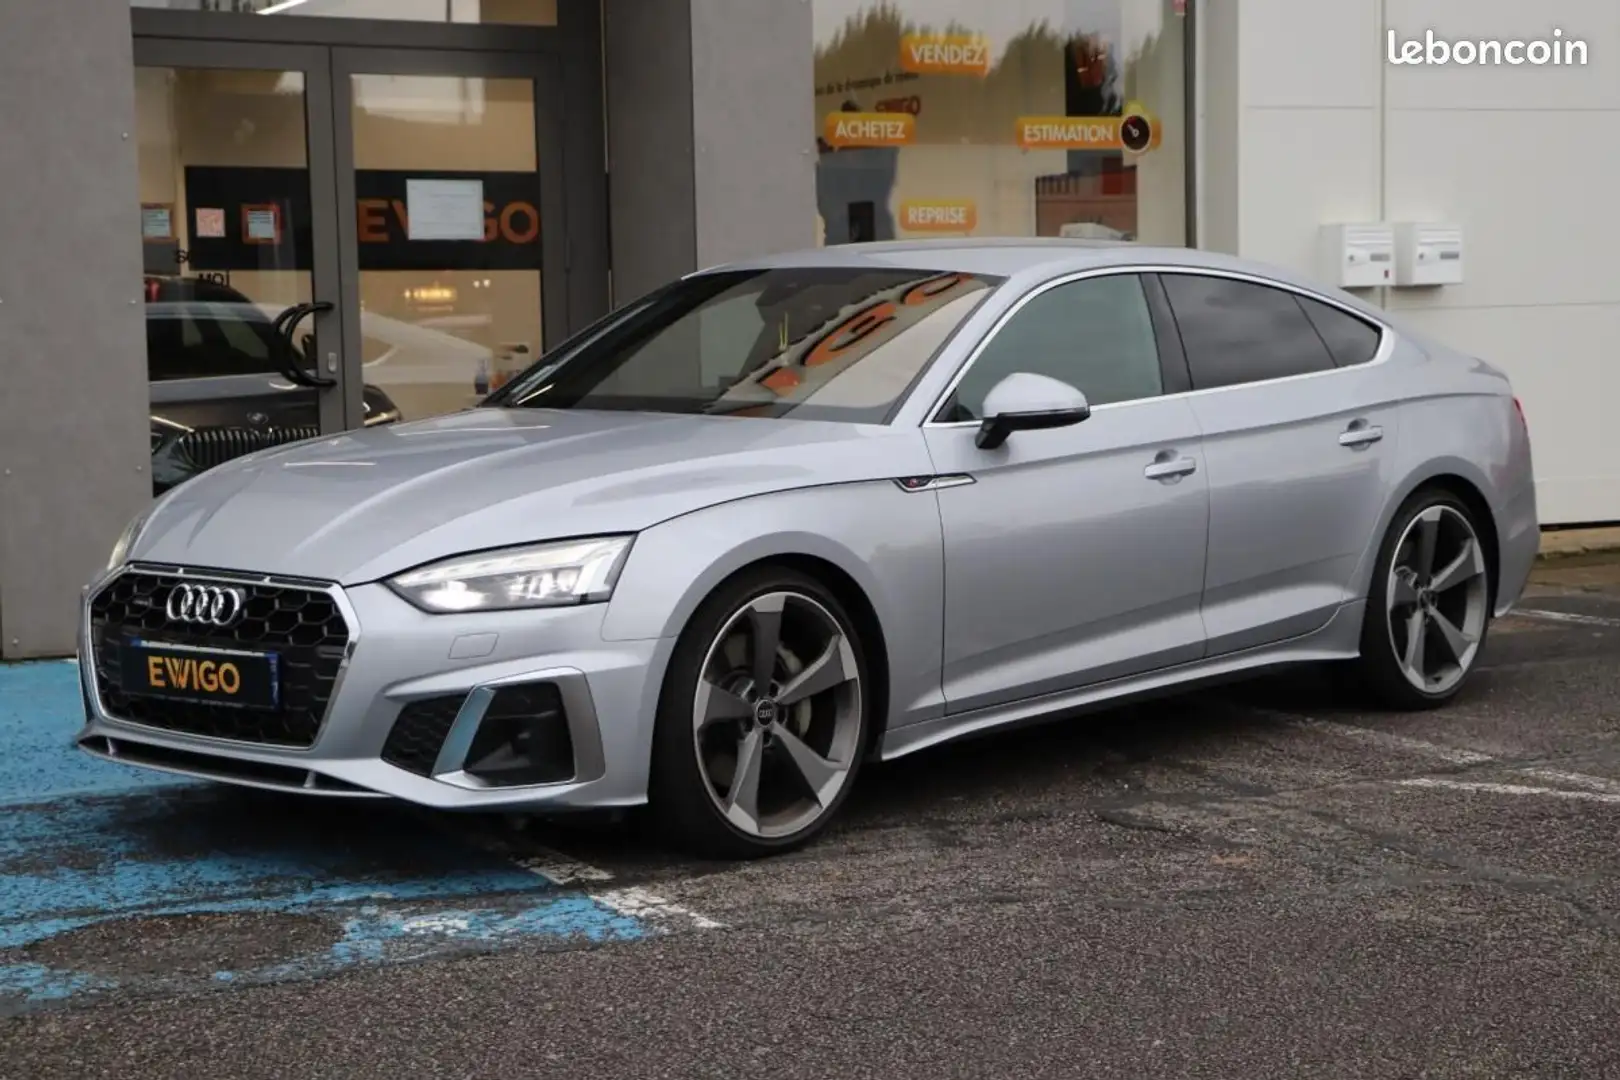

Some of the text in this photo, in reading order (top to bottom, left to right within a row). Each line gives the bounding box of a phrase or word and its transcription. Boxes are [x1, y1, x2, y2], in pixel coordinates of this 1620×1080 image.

[910, 43, 984, 65] VENDEZ
[835, 120, 906, 139] ACHETEZ
[1024, 124, 1114, 142] ESTIMATION
[908, 206, 967, 224] REPRISE
[147, 655, 241, 694] EWIGO
